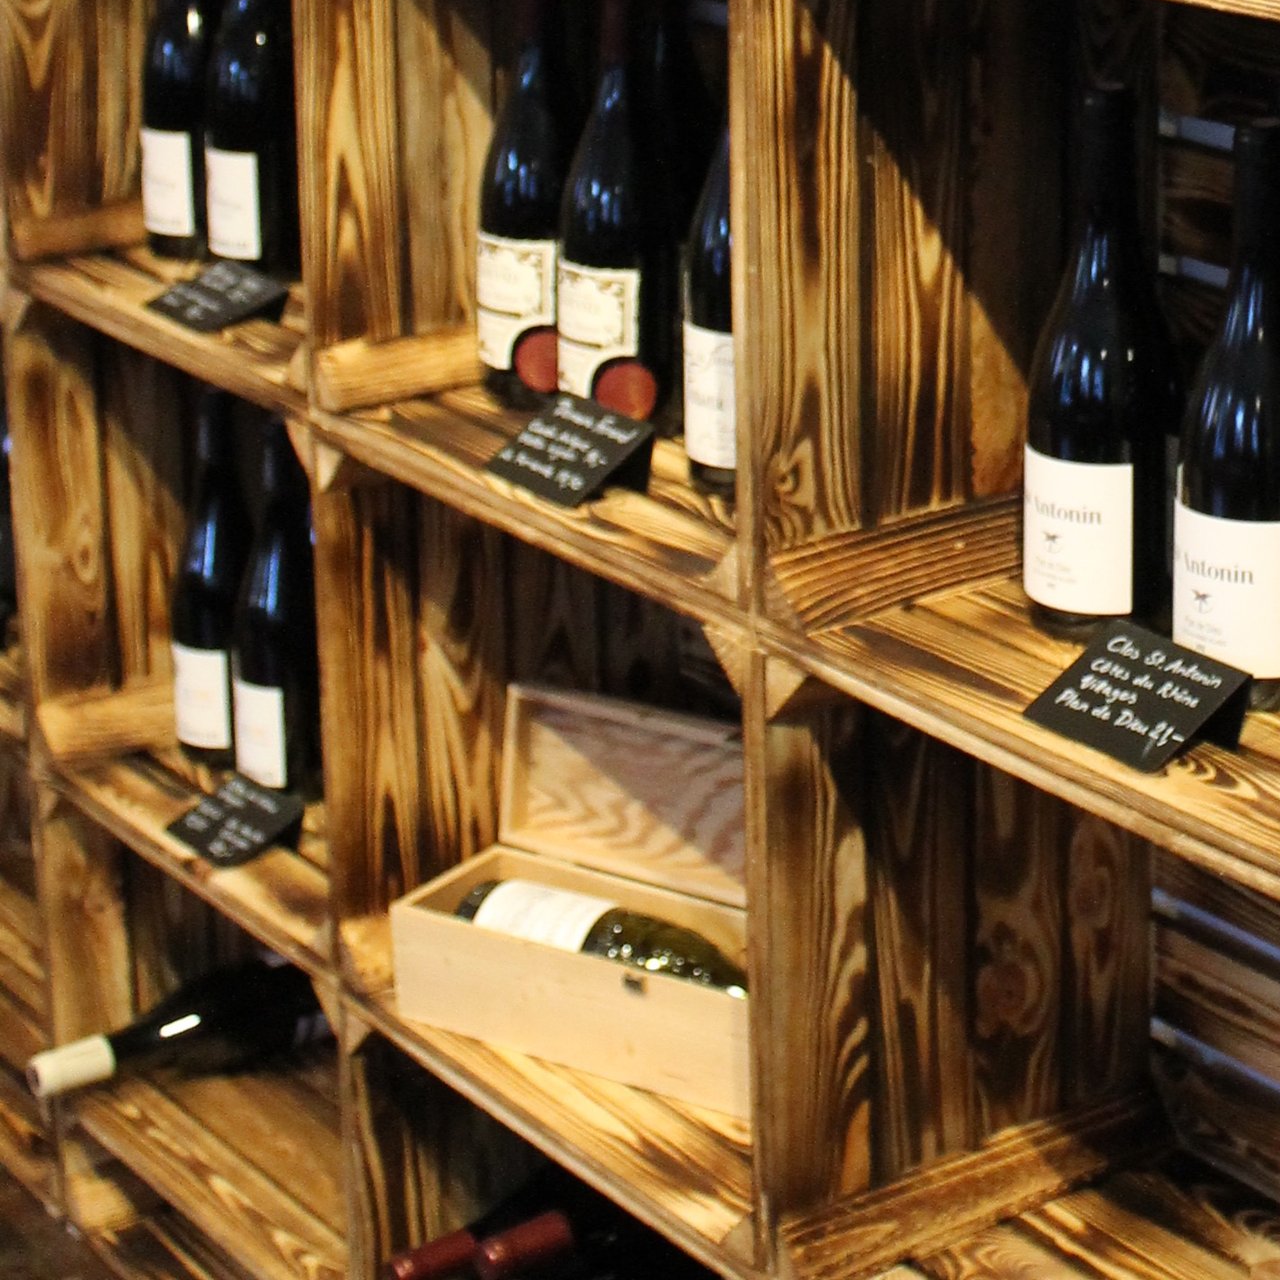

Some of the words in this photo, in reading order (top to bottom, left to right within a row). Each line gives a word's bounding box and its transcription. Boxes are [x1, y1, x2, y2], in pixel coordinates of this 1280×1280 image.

[1182, 555, 1256, 586] Antonin
[1106, 634, 1141, 661] Clos
[1054, 687, 1090, 713] Plan
